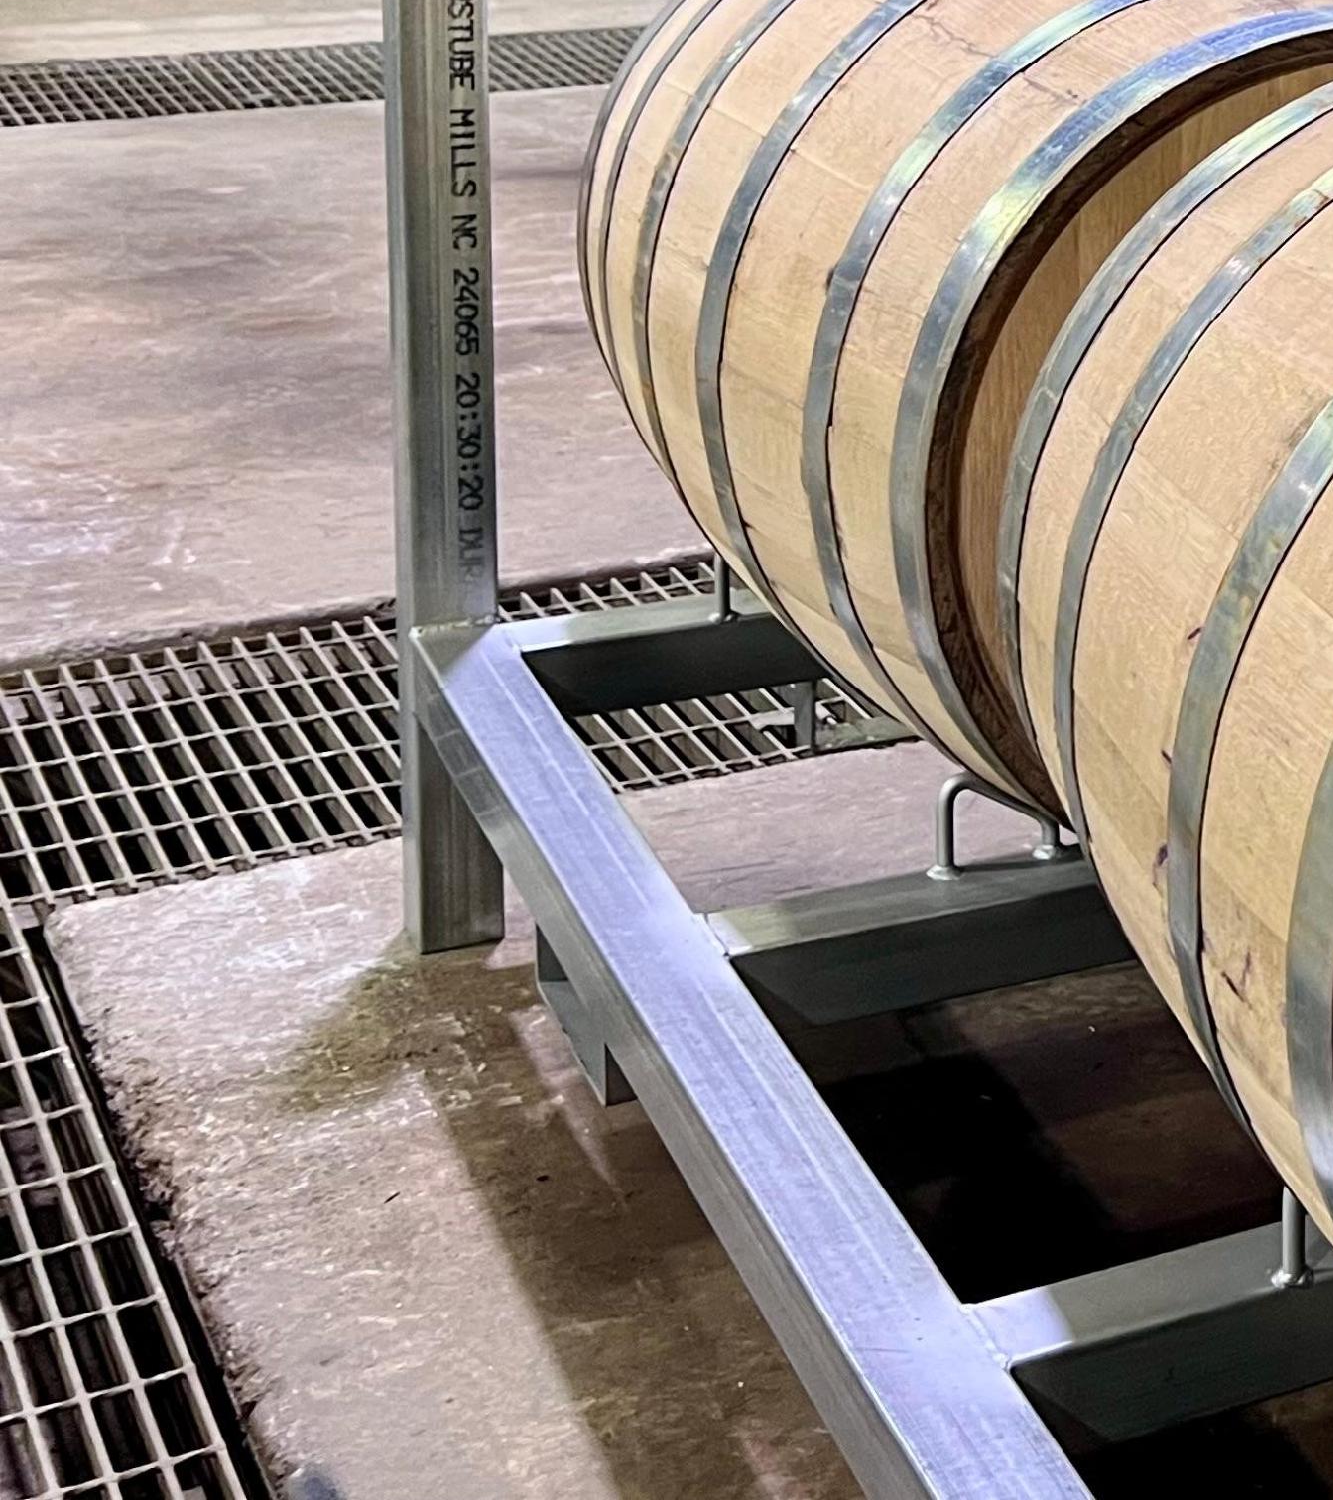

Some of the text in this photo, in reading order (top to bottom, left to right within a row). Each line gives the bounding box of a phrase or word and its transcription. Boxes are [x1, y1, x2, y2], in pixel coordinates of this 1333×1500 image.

[449, 108, 477, 198] MILLS
[451, 213, 477, 249] NC
[453, 267, 480, 356] 24065
[455, 372, 484, 511] 20:30:20
